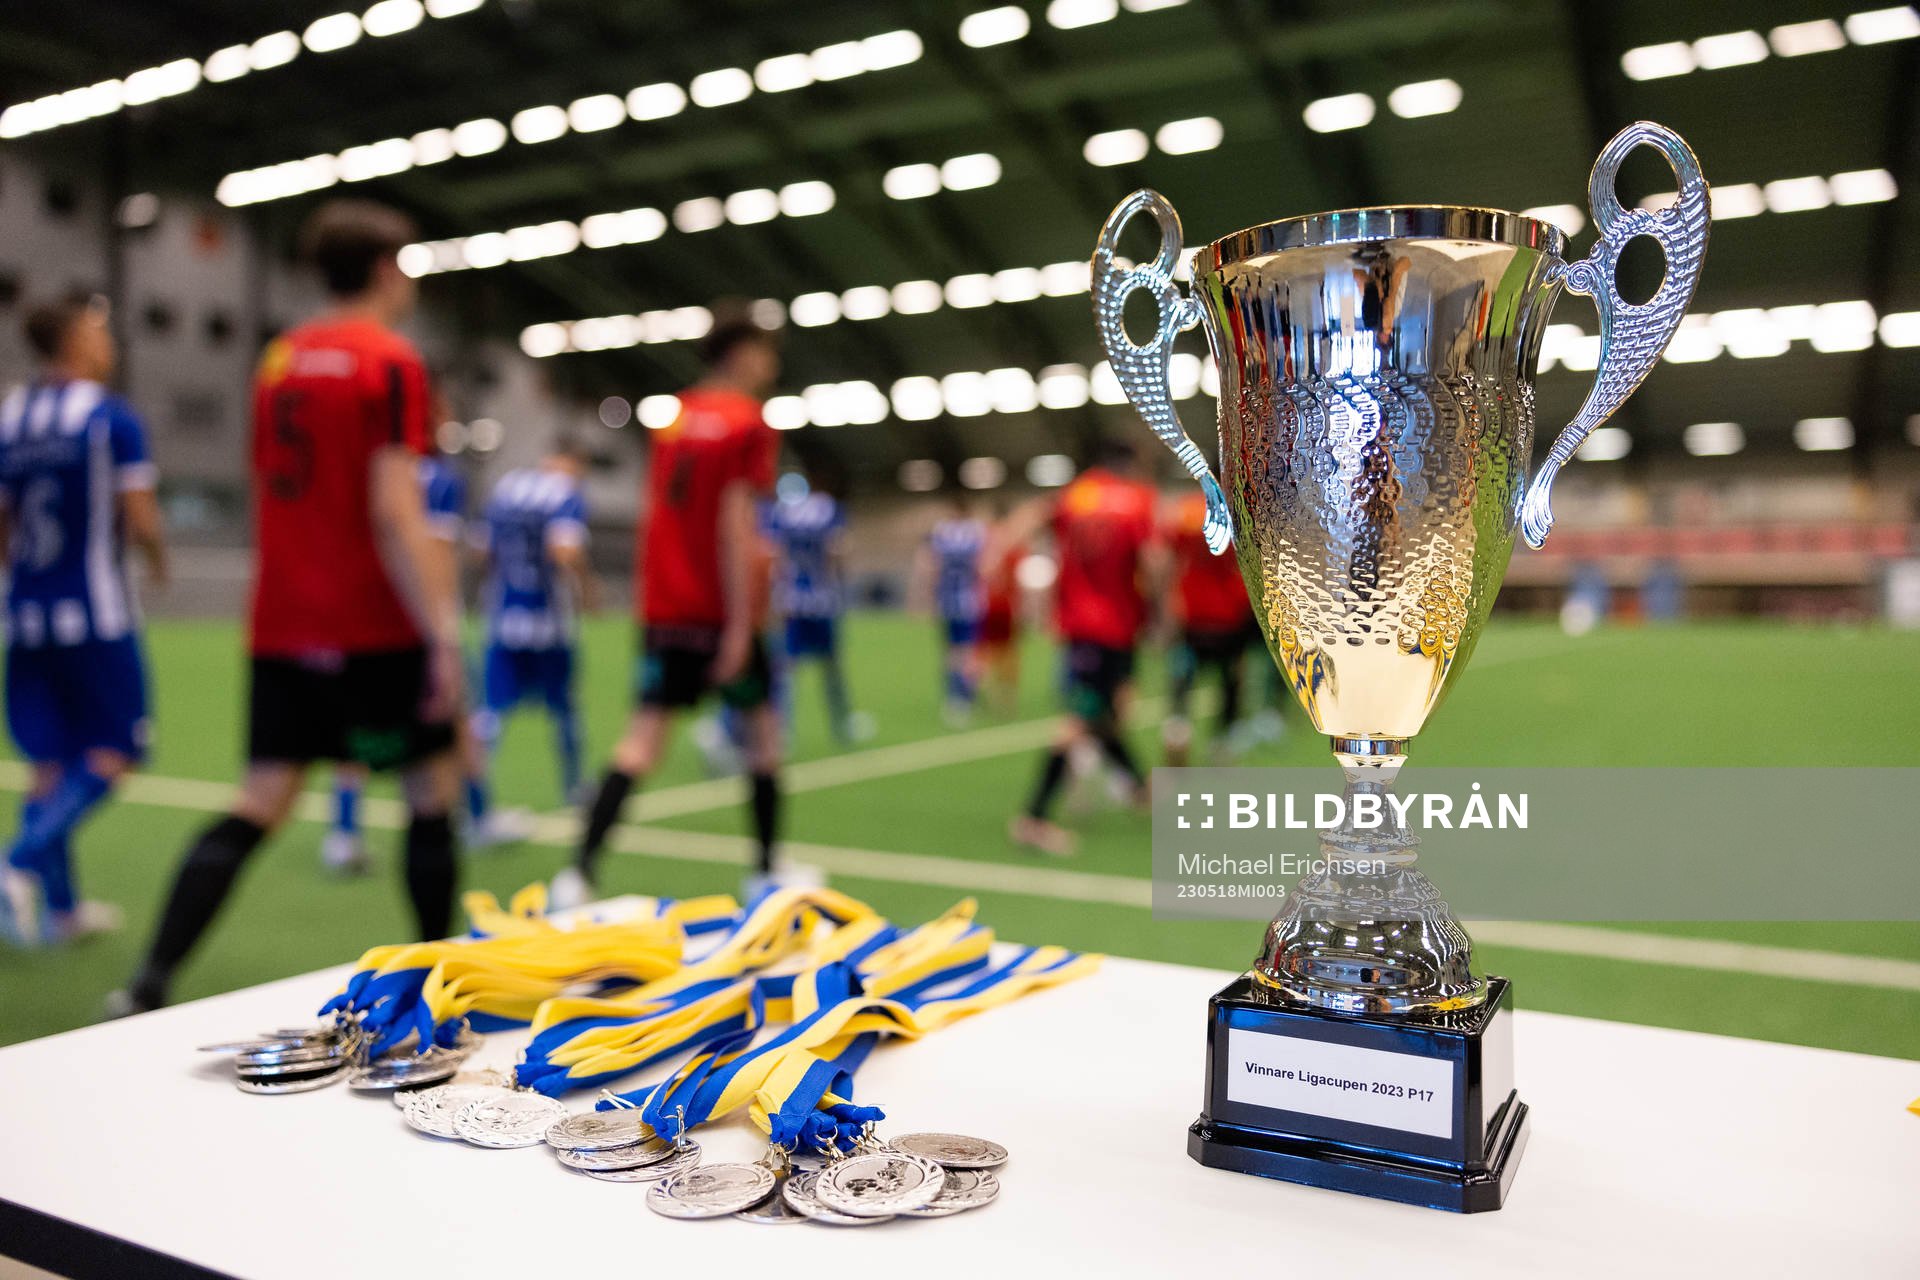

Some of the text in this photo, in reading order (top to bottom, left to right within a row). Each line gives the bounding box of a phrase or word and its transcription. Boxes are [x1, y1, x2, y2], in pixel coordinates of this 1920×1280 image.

[1245, 1061, 1434, 1103] Vinnare Ligacupen 2023 P17
